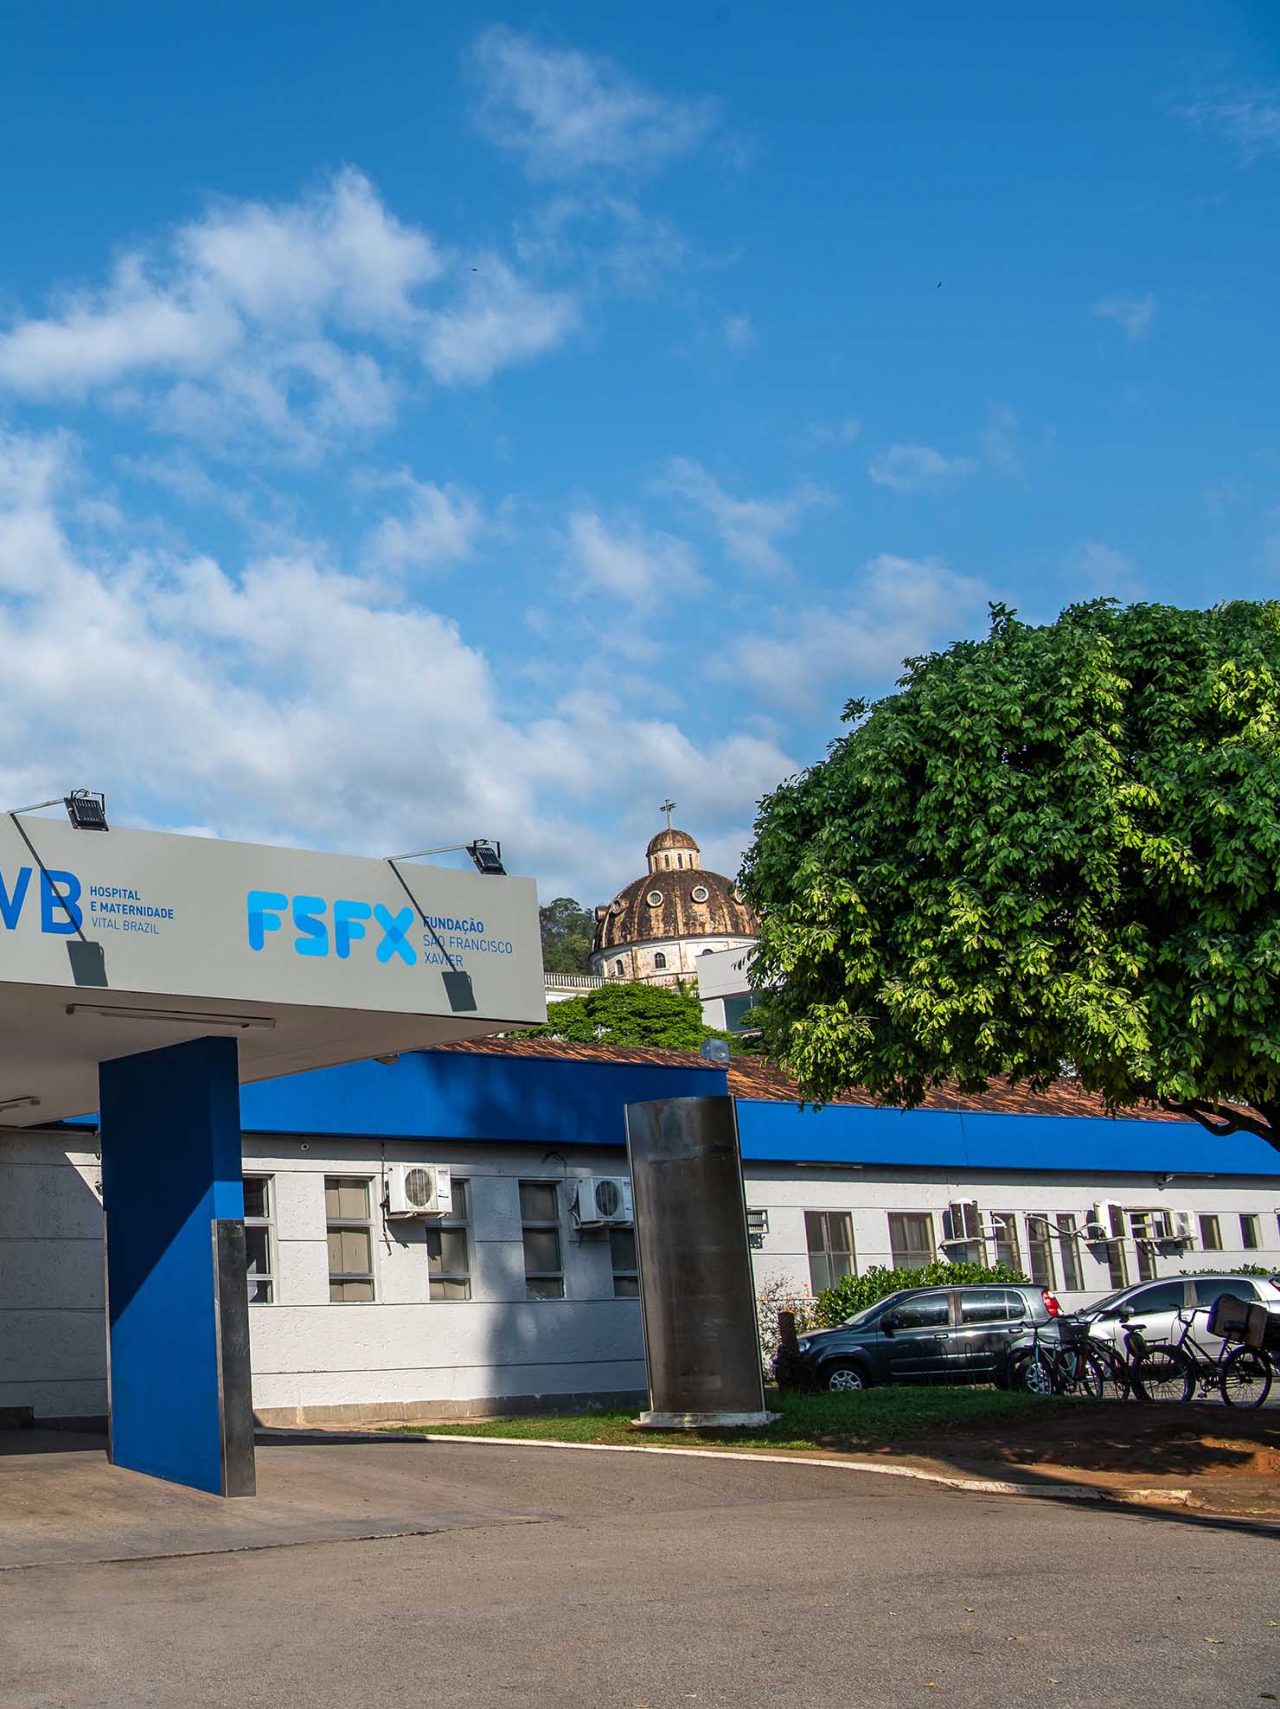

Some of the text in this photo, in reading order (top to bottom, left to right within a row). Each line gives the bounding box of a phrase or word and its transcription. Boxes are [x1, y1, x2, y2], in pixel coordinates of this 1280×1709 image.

[90, 886, 141, 900] HOSPITAL
[90, 901, 174, 919] E MATERNIDADE
[92, 917, 160, 935] VITAL BRAZIL
[247, 890, 417, 966] FSFX
[423, 916, 484, 934] FUNDAÇÃO
[449, 936, 513, 954] FRANCISCO
[424, 951, 464, 967] XAVIER
